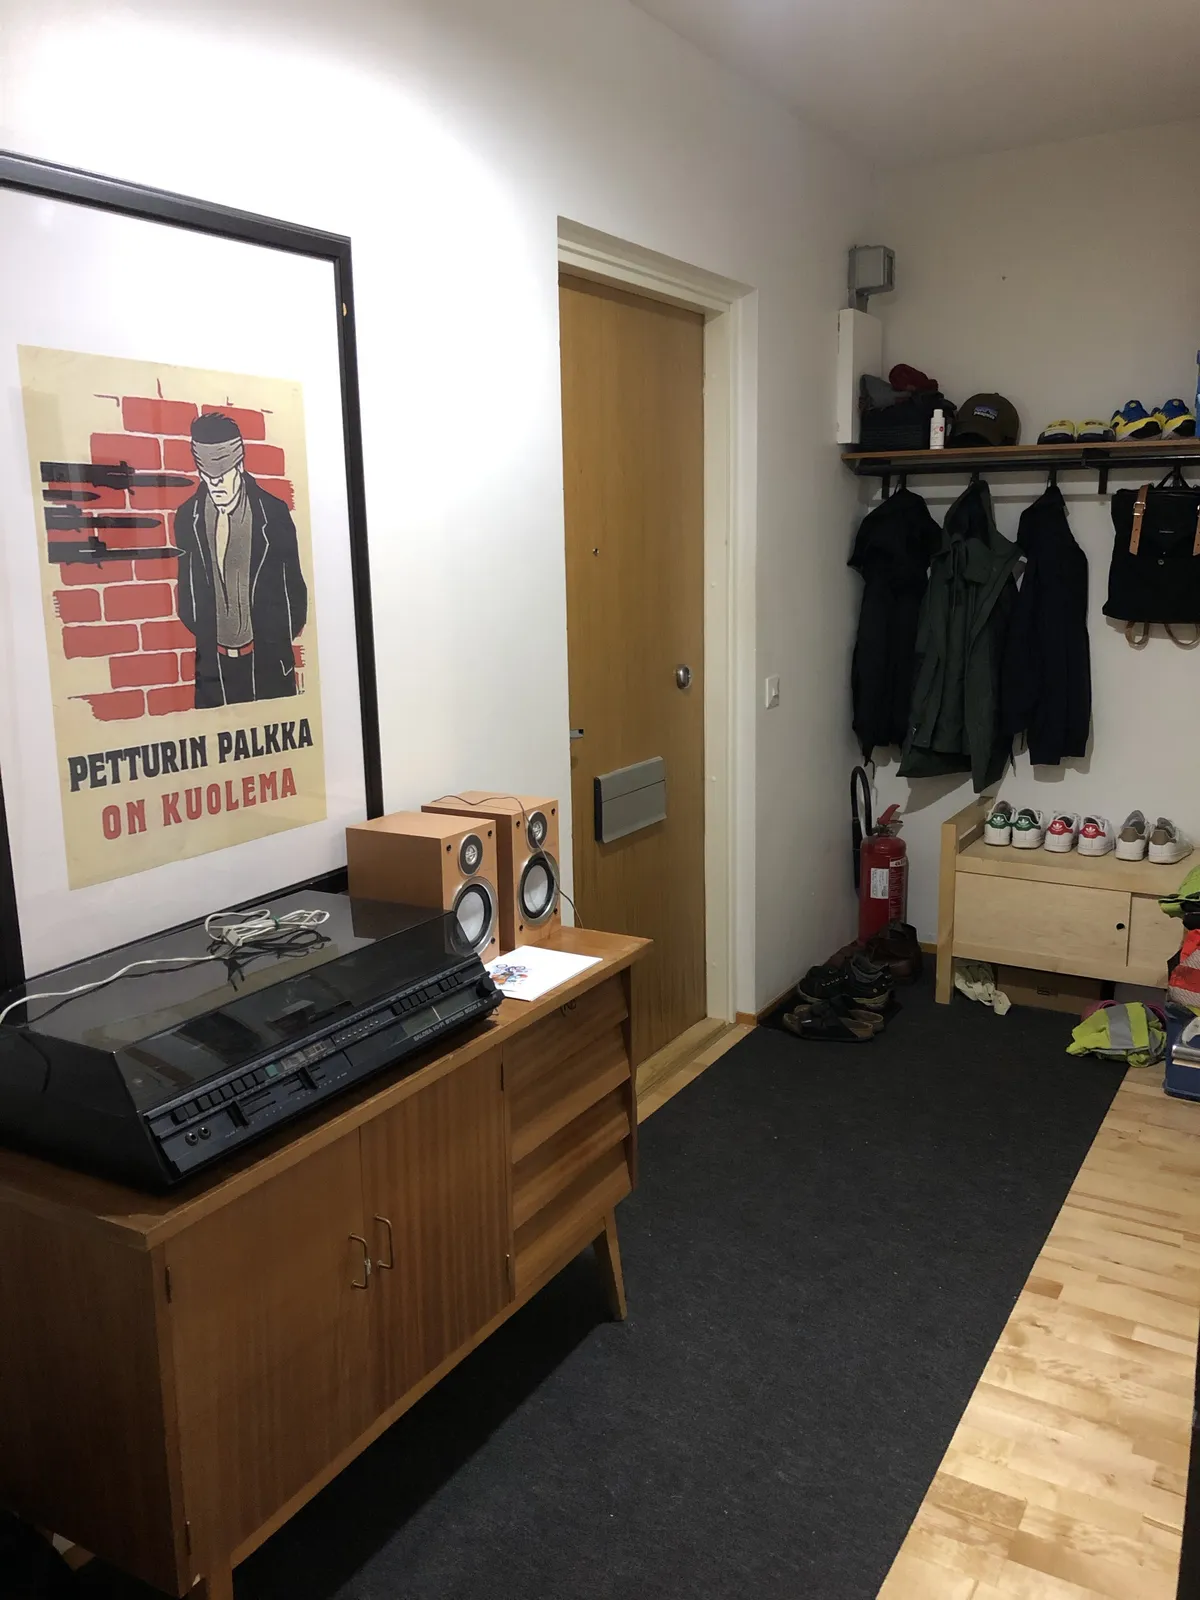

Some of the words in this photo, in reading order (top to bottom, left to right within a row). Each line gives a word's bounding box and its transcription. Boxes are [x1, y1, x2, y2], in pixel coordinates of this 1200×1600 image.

[68, 735, 208, 792] PETTURIN
[218, 718, 313, 764] PALKKA
[102, 799, 147, 840] ON
[161, 767, 297, 827] KUOLEMA
